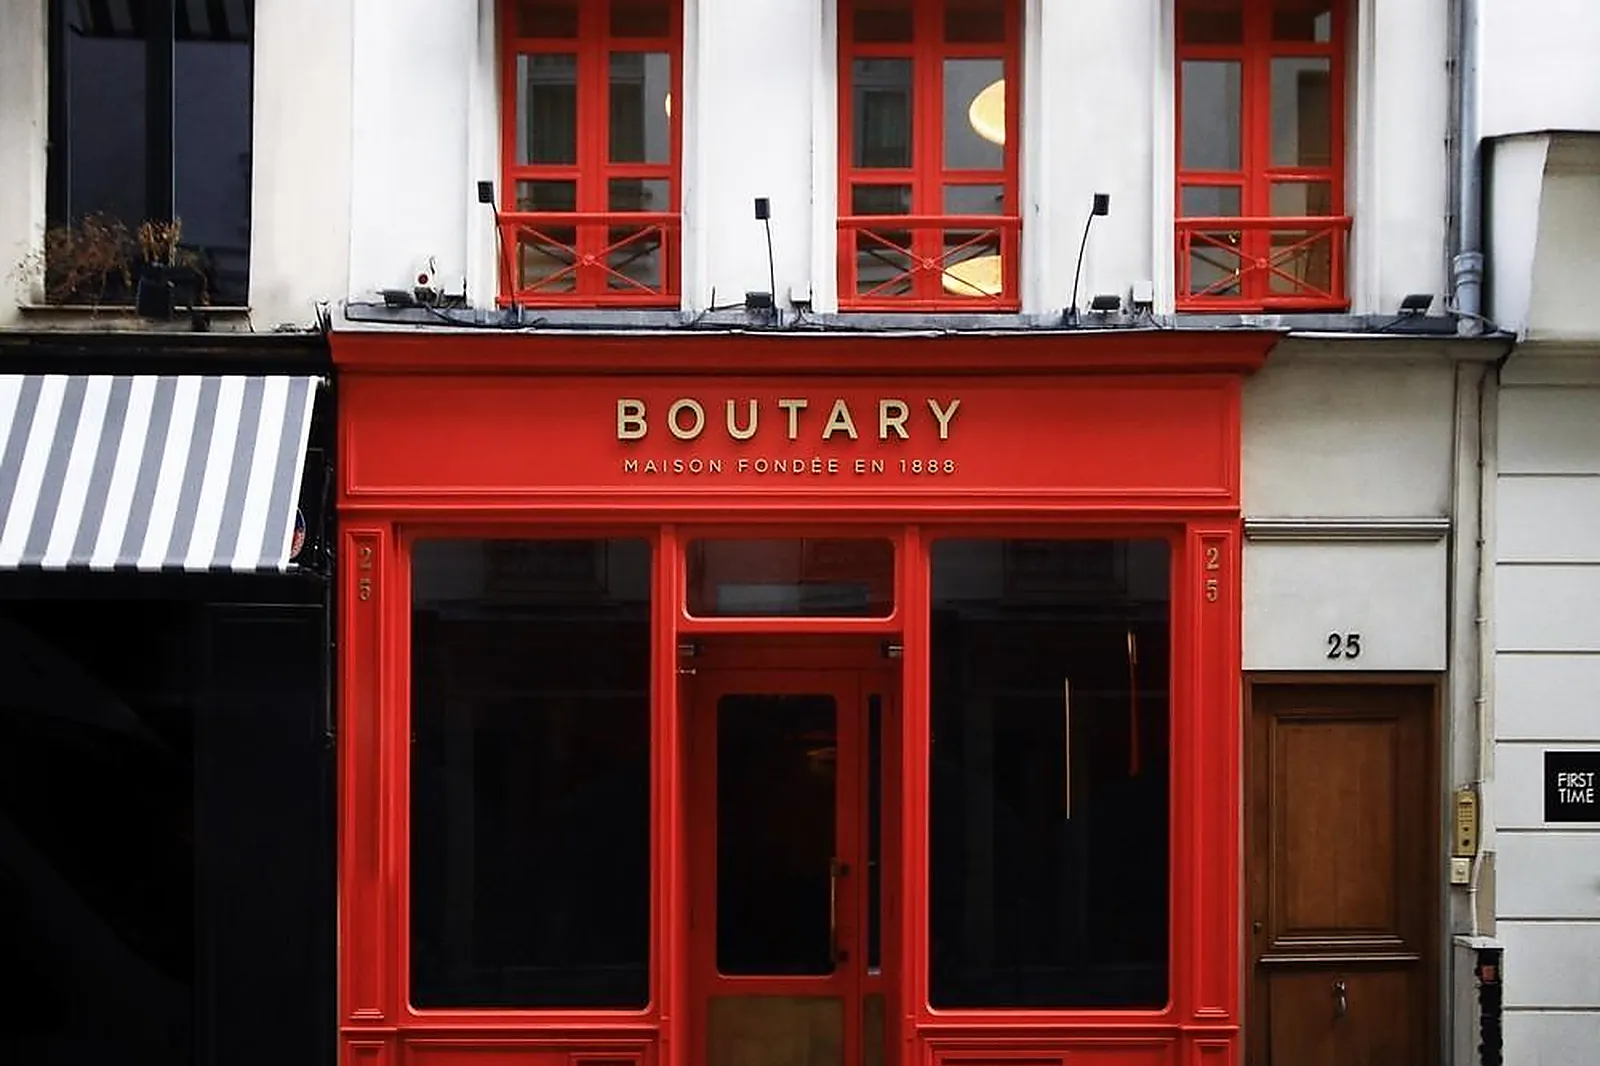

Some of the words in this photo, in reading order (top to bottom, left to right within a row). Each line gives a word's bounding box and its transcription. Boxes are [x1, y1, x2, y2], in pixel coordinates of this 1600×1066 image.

[617, 398, 962, 440] BOUTARY
[624, 459, 722, 473] MAISON
[738, 456, 839, 473] FONDÉE
[855, 459, 885, 473] EN
[900, 459, 955, 474] 1888
[1205, 547, 1220, 602] 25
[1327, 633, 1361, 659] 25
[1558, 772, 1595, 787] FIRST
[1558, 788, 1595, 803] TIME
